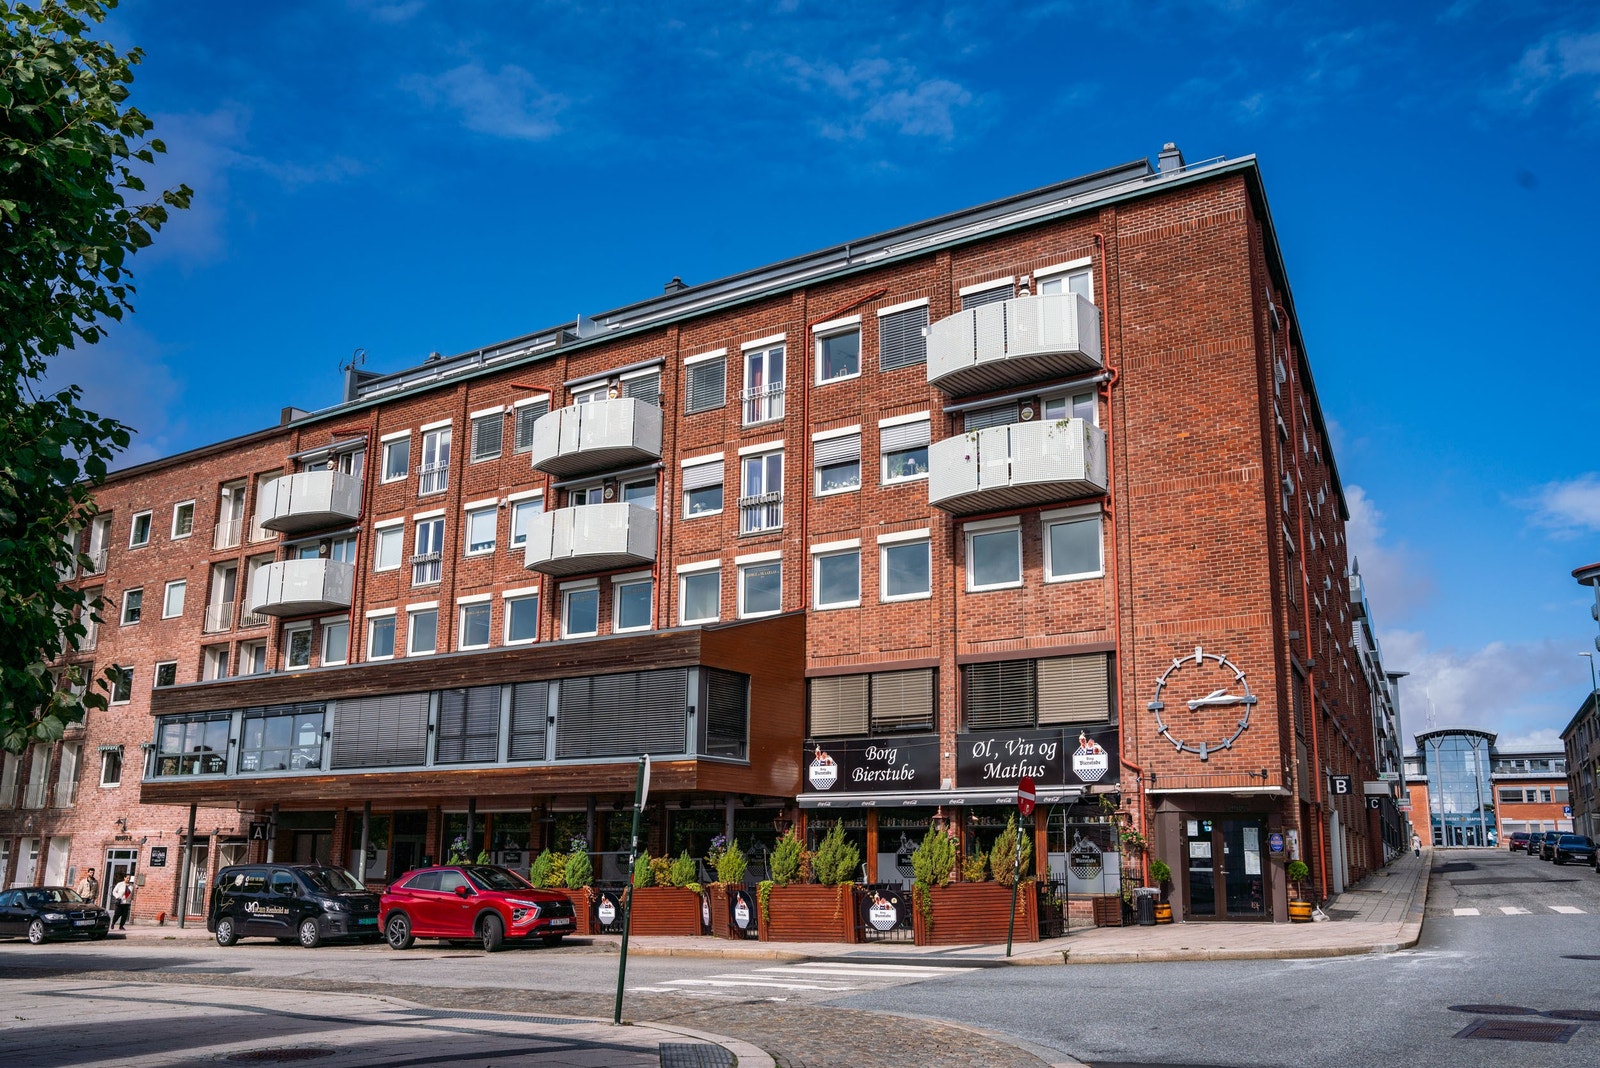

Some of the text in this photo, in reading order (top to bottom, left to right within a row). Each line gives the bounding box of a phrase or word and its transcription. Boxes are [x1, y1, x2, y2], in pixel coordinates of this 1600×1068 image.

[865, 745, 898, 765] Borg
[1005, 737, 1035, 756] Vin
[1038, 742, 1058, 761] og
[852, 763, 915, 782] Bierstube
[983, 759, 1046, 779] Mathus
[1336, 780, 1347, 794] B
[1371, 799, 1379, 809] C
[253, 826, 263, 840] A
